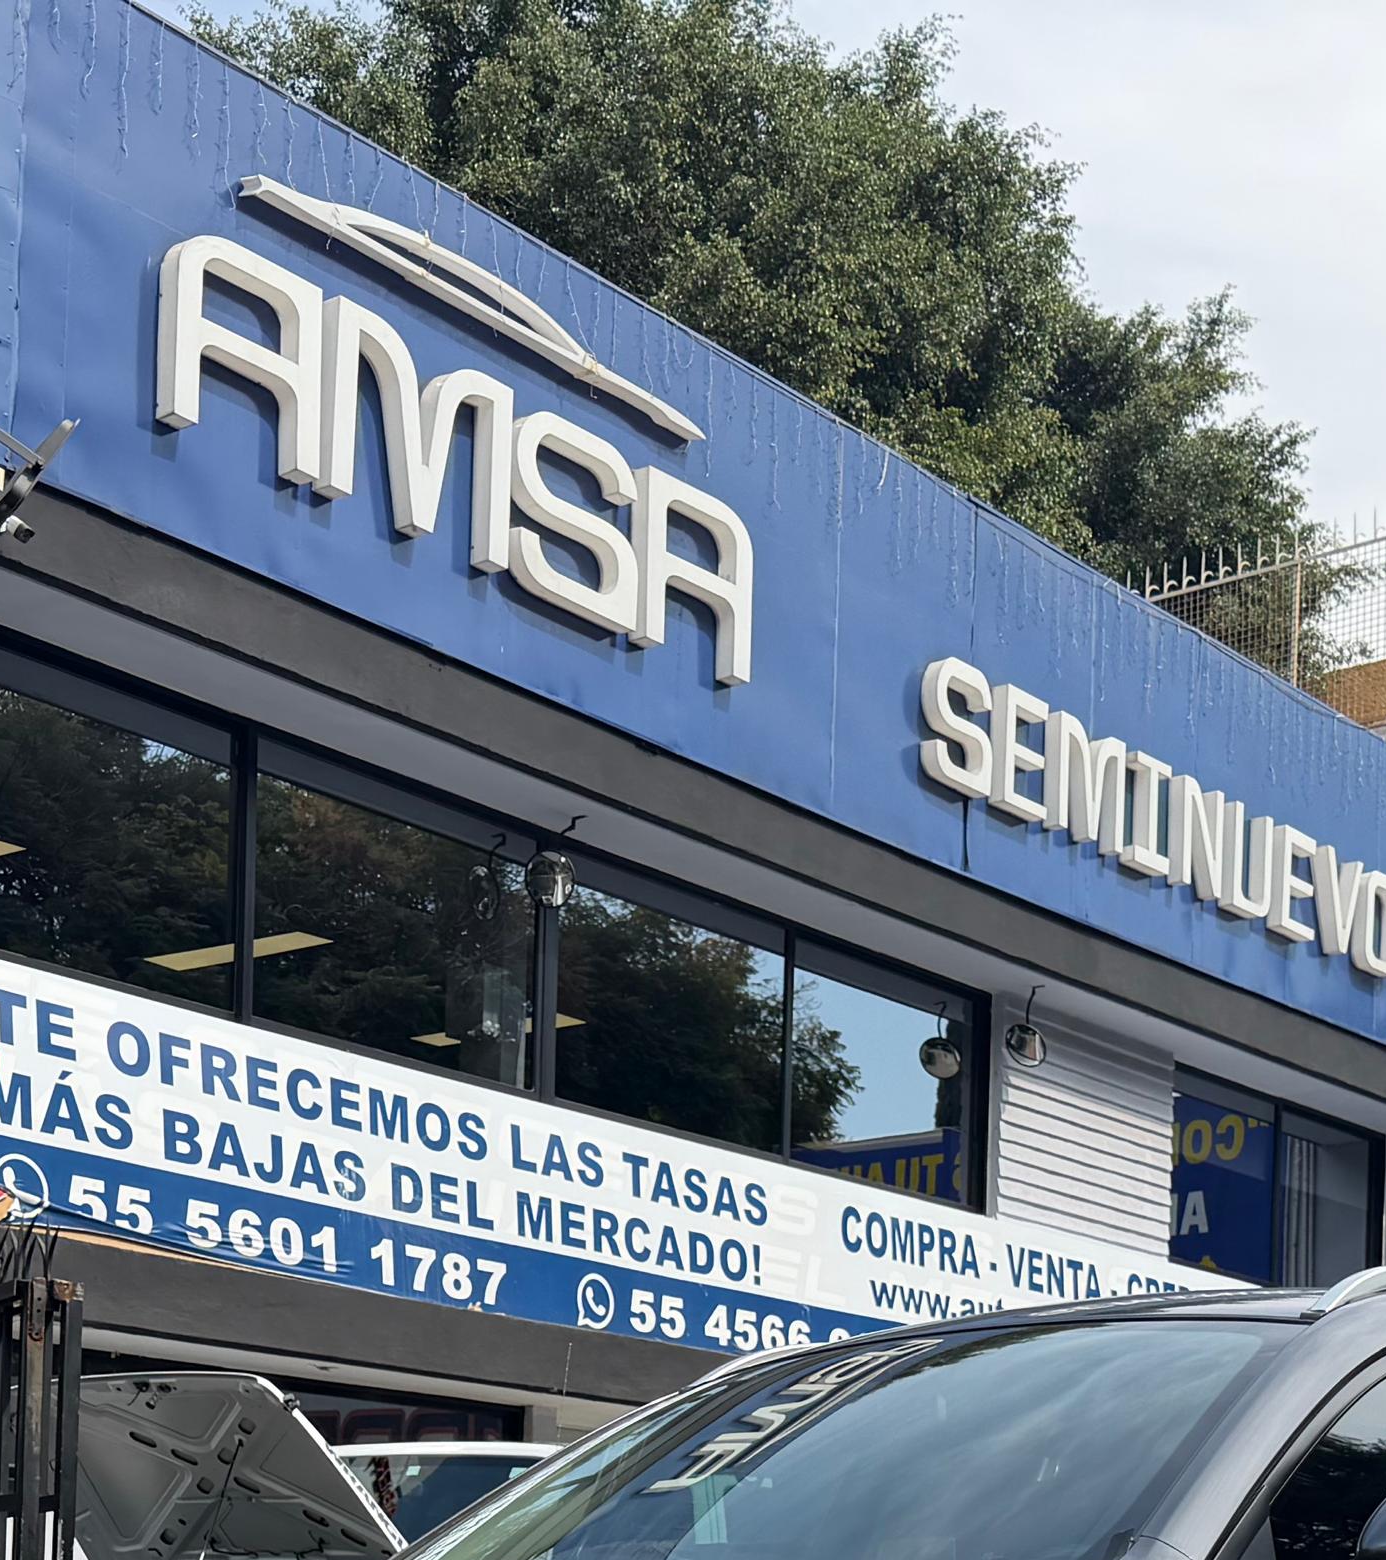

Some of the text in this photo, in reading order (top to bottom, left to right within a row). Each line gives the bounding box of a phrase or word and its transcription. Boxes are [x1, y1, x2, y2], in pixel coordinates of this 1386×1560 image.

[156, 234, 753, 687] AMSA
[108, 1022, 489, 1160] OFRECEMOS
[511, 1125, 604, 1189] LAS
[623, 1152, 769, 1227] TASAS
[164, 1110, 367, 1202] BAJAS
[392, 1165, 494, 1231] DEL
[517, 1192, 763, 1286] MERCADO!
[68, 1174, 507, 1306] 55 5601 1787
[841, 1206, 981, 1280] COMPRA
[1006, 1243, 1101, 1300] VENTA
[629, 1289, 811, 1351] 55 4566
